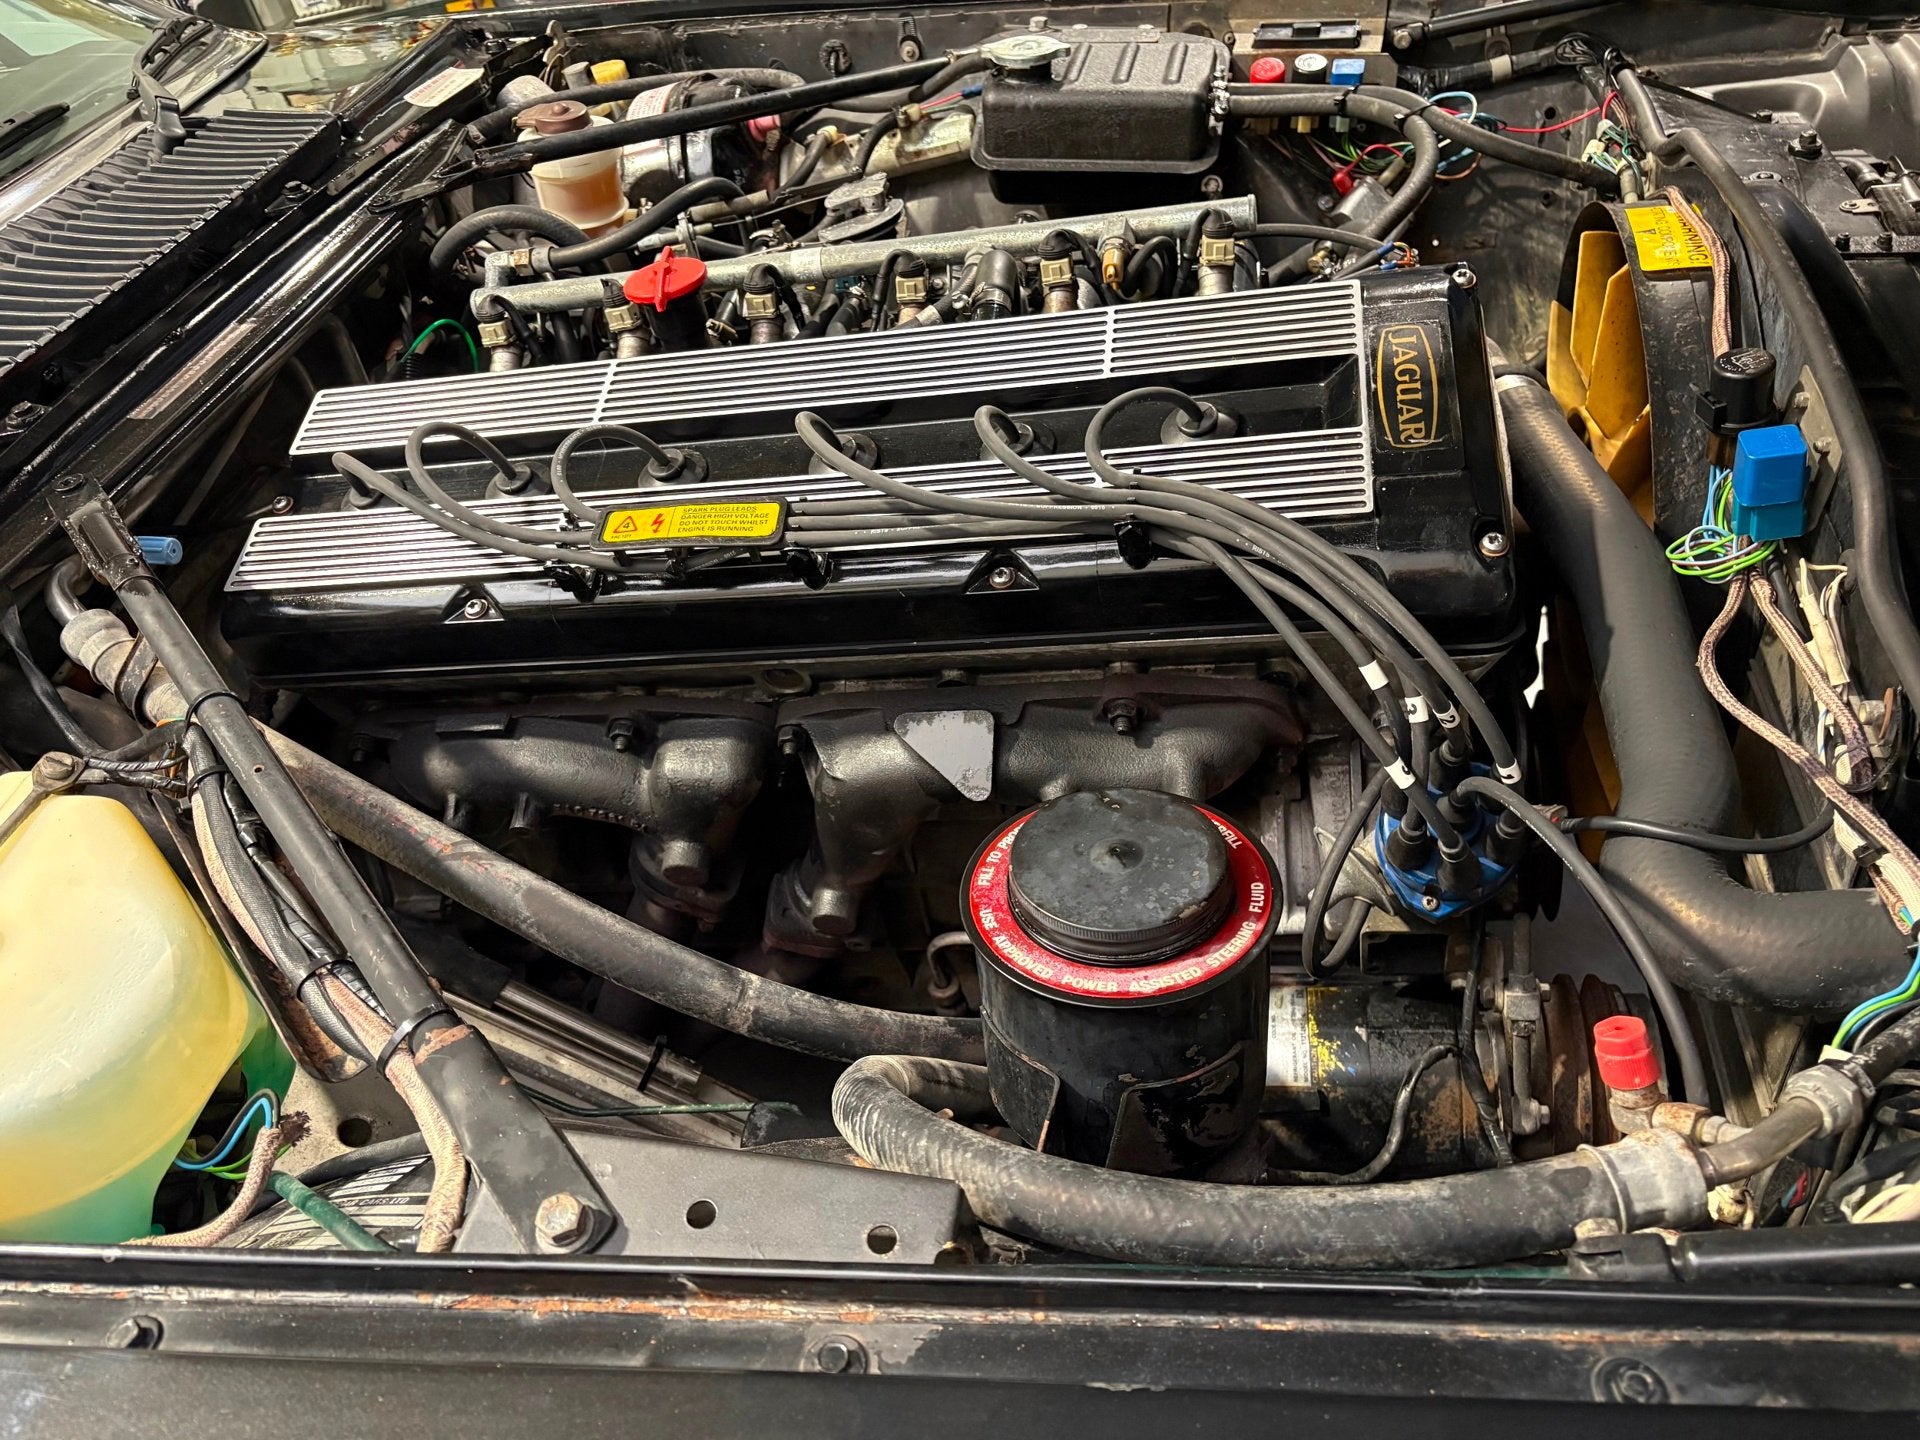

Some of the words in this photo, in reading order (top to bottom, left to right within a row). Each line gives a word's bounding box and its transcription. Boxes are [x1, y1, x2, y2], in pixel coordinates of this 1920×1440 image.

[1677, 213, 1710, 264] ARNING!
[1388, 332, 1426, 443] JAGUAR
[978, 865, 994, 886] FILL
[986, 851, 1002, 863] TO
[980, 907, 998, 931] USE
[992, 932, 1053, 978] APPROVED
[1061, 975, 1118, 992] POWER
[1129, 966, 1201, 993] ASSISTED
[1206, 921, 1257, 968] STEERING
[1249, 882, 1265, 913] FLUID
[389, 1197, 410, 1205] LTD
